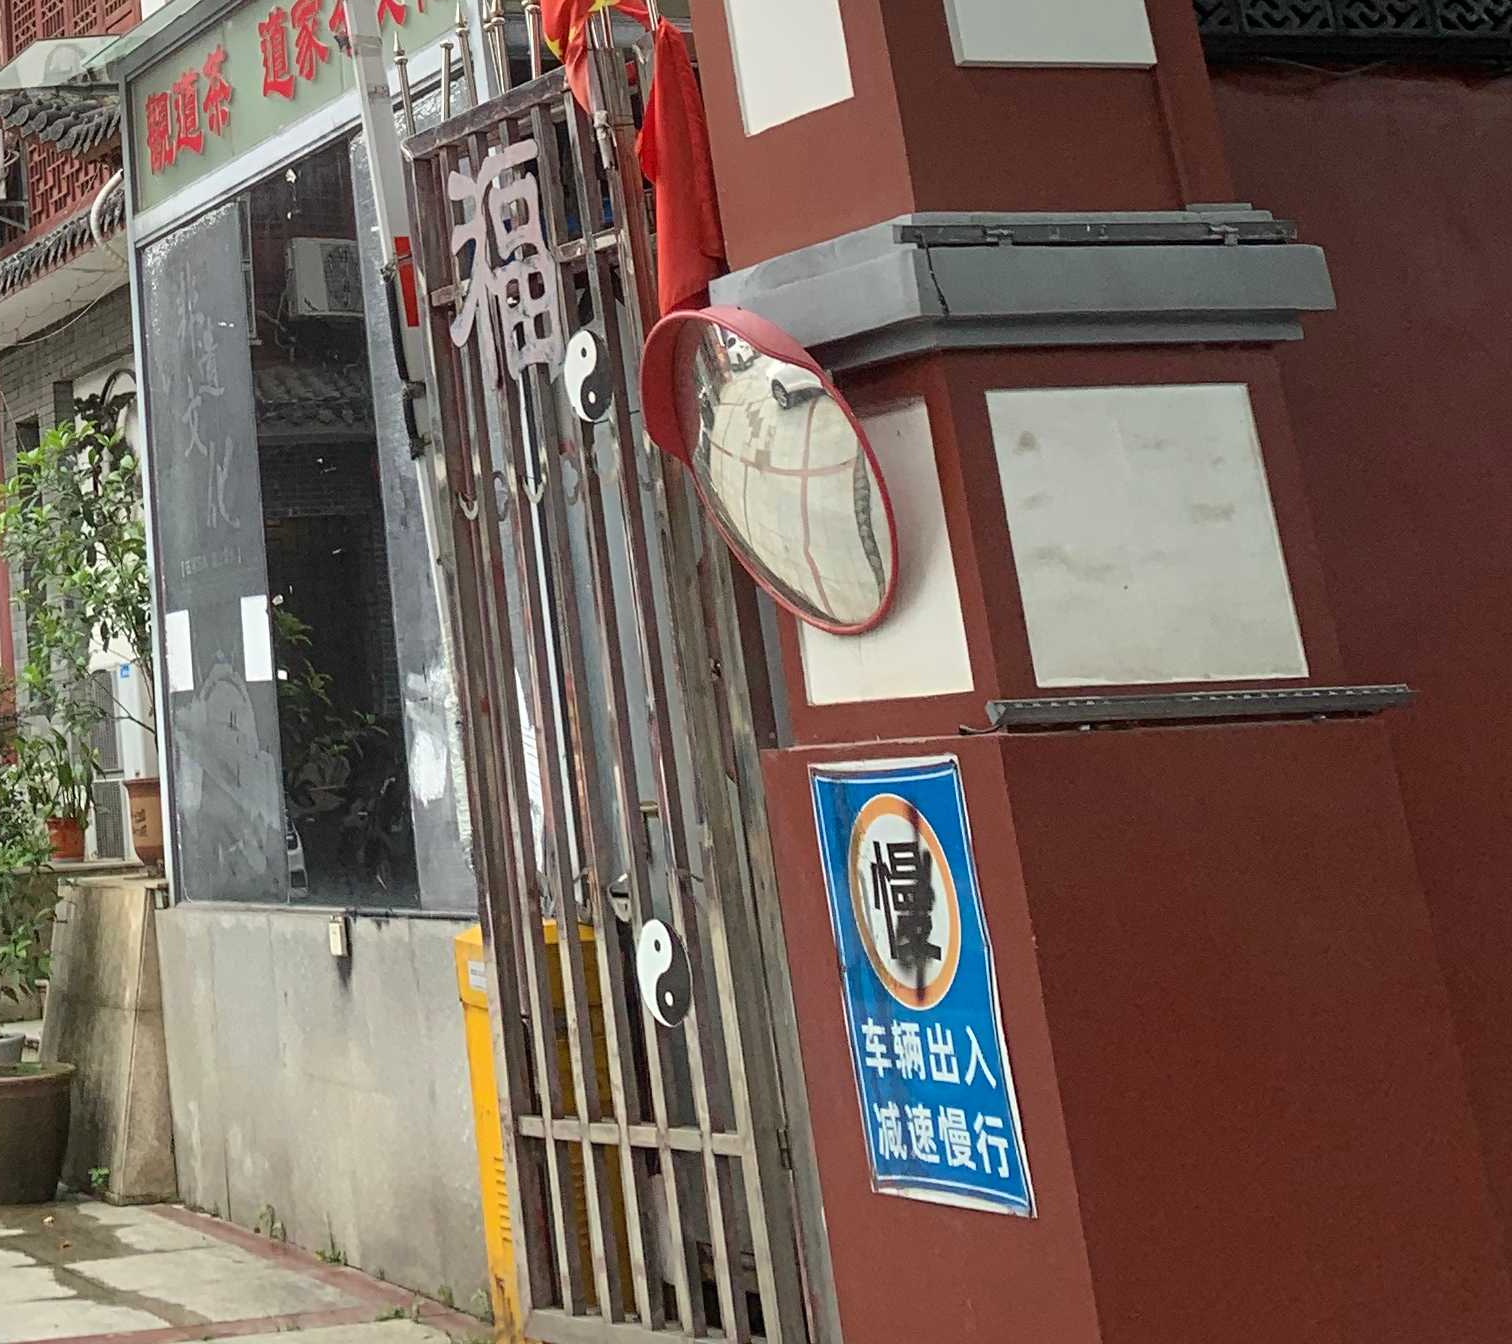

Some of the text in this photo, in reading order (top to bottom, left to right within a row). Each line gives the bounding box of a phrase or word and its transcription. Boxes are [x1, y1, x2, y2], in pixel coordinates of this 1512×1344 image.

[447, 138, 564, 391] 福
[861, 1017, 997, 1090] 车辆出入
[875, 1100, 1010, 1179] 减速慢行
